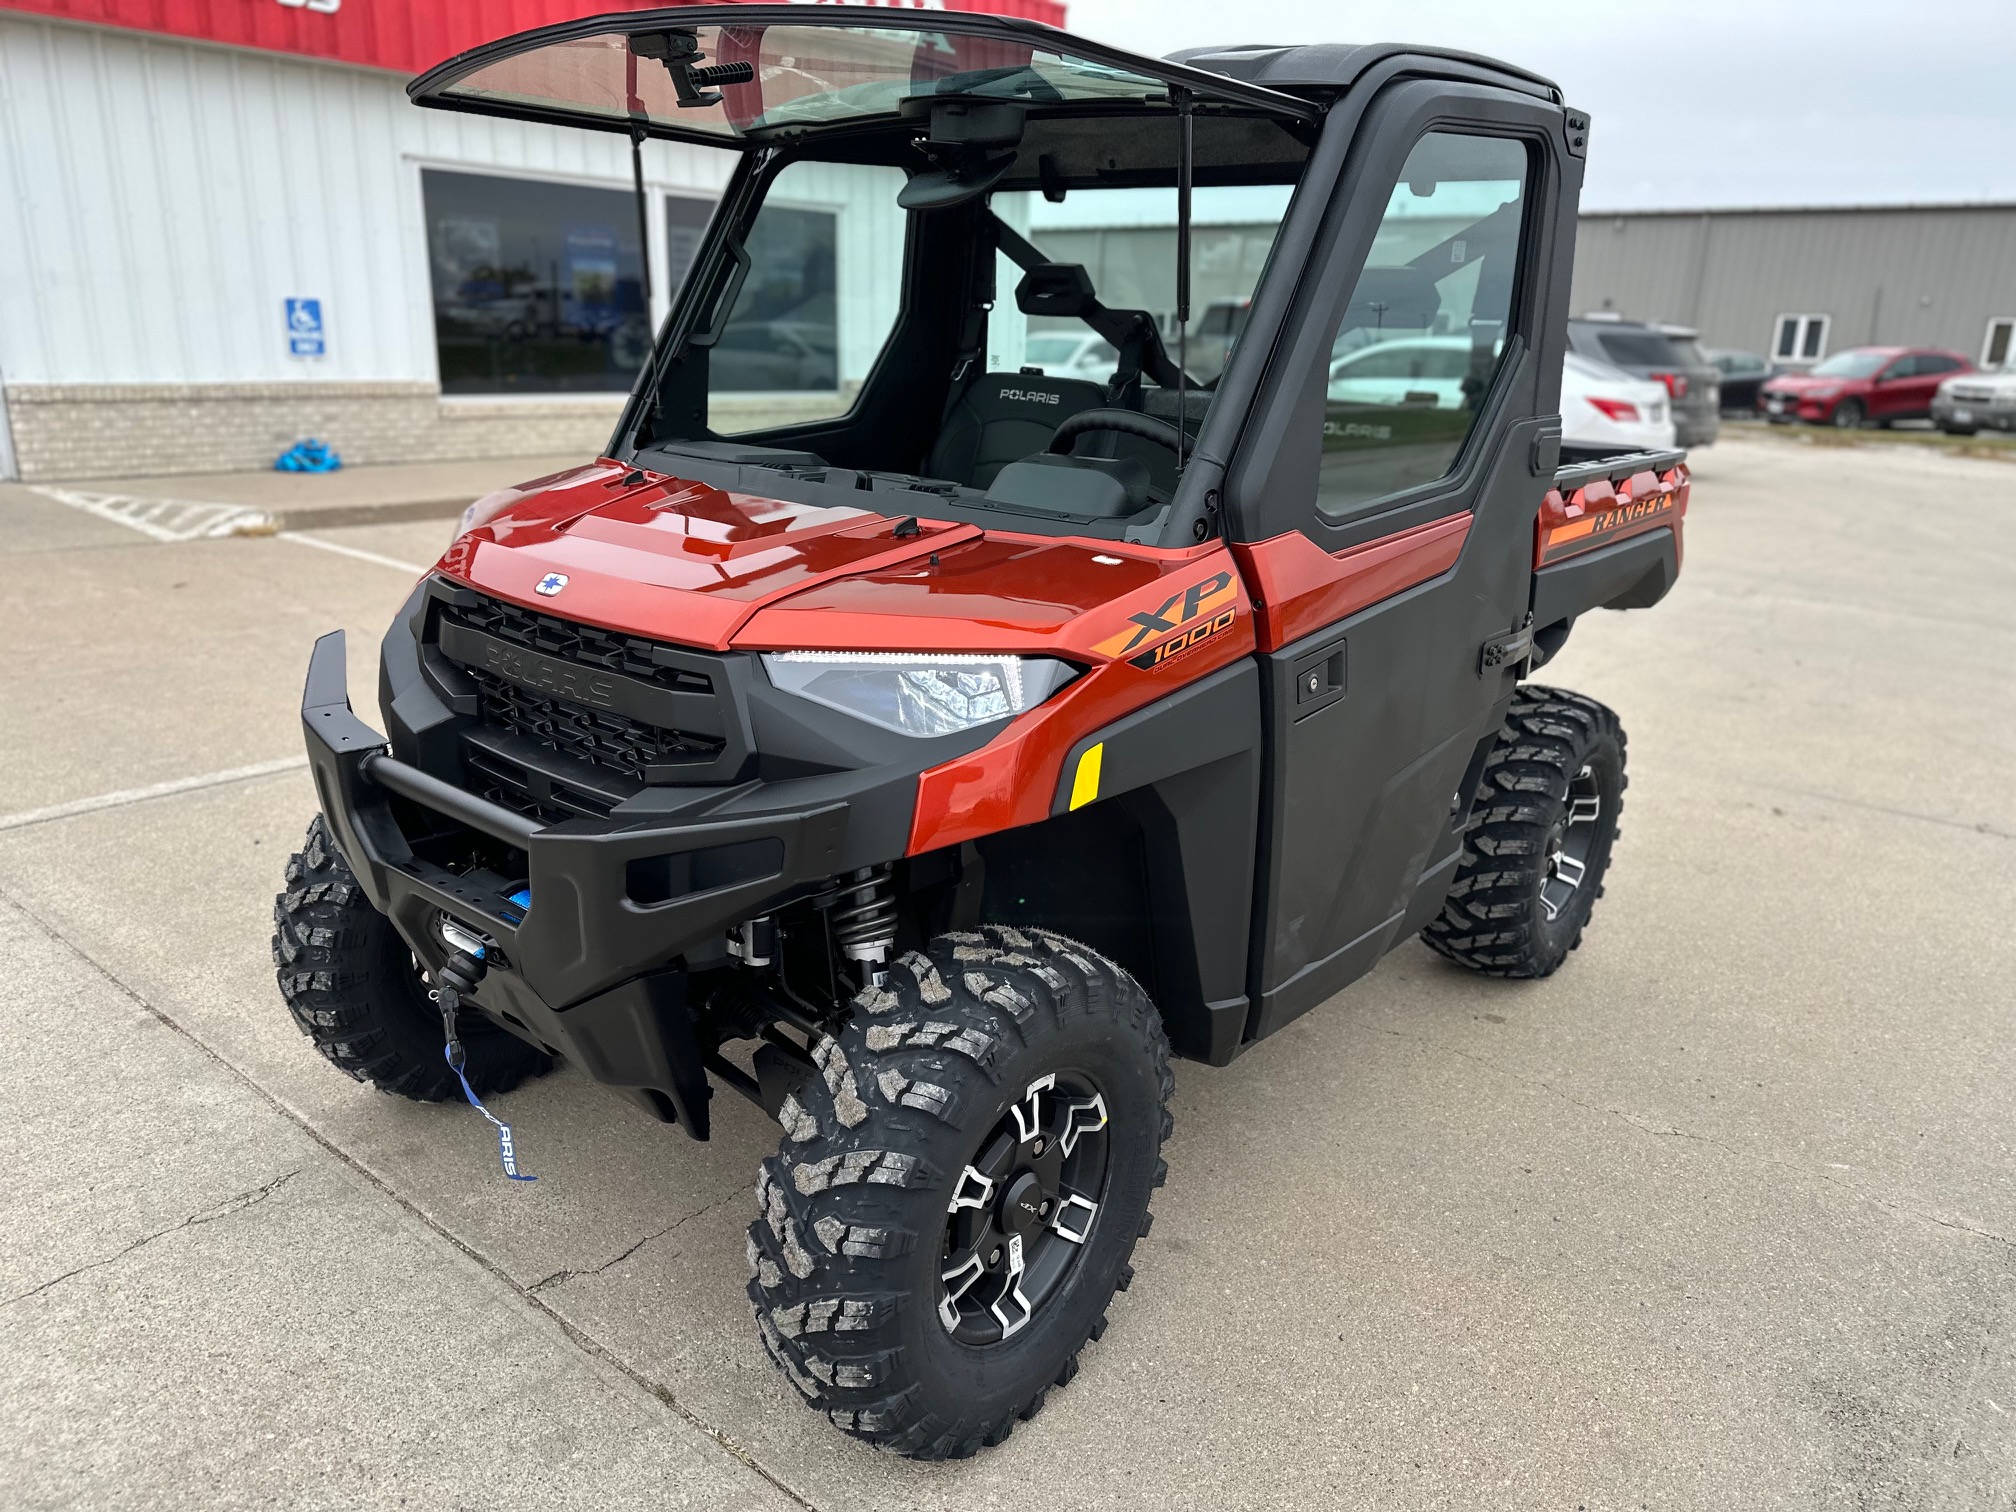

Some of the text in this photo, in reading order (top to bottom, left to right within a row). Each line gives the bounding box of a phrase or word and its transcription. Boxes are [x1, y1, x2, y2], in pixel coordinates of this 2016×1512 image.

[1000, 389, 1060, 405] POLARIS
[1324, 421, 1391, 439] OLARIS
[1592, 495, 1667, 533] RANGER
[1119, 570, 1233, 655] XP
[1155, 609, 1235, 664] 1000
[486, 643, 613, 706] POLARIS
